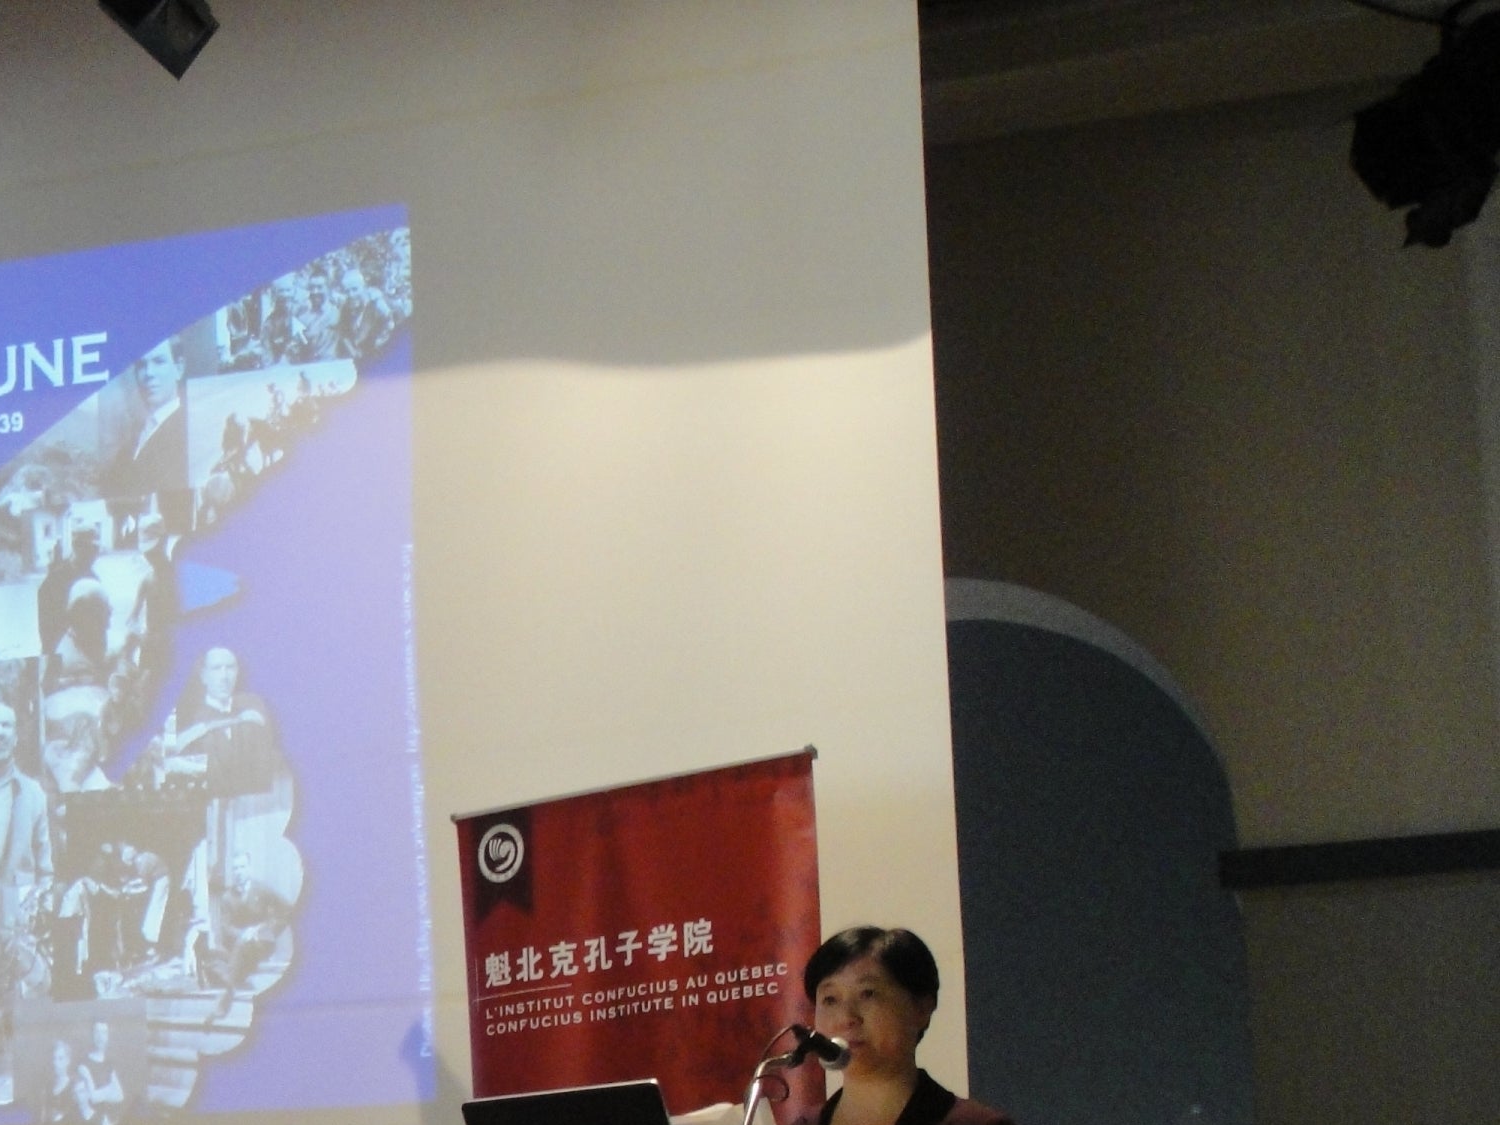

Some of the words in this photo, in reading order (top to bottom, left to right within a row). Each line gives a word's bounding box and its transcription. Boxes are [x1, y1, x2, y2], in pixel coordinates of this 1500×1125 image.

[485, 918, 714, 989] 魁北克孔子学院
[486, 995, 574, 1021] L'INSTITUT
[582, 979, 679, 1005] CONFUCIUS
[686, 975, 708, 991] AU
[715, 962, 789, 985] QUÉBEC
[486, 1011, 583, 1036] CONFUCIUS
[590, 997, 674, 1023] INSTITUTE
[682, 993, 699, 1008] IN
[706, 981, 779, 1004] QUEBEC
